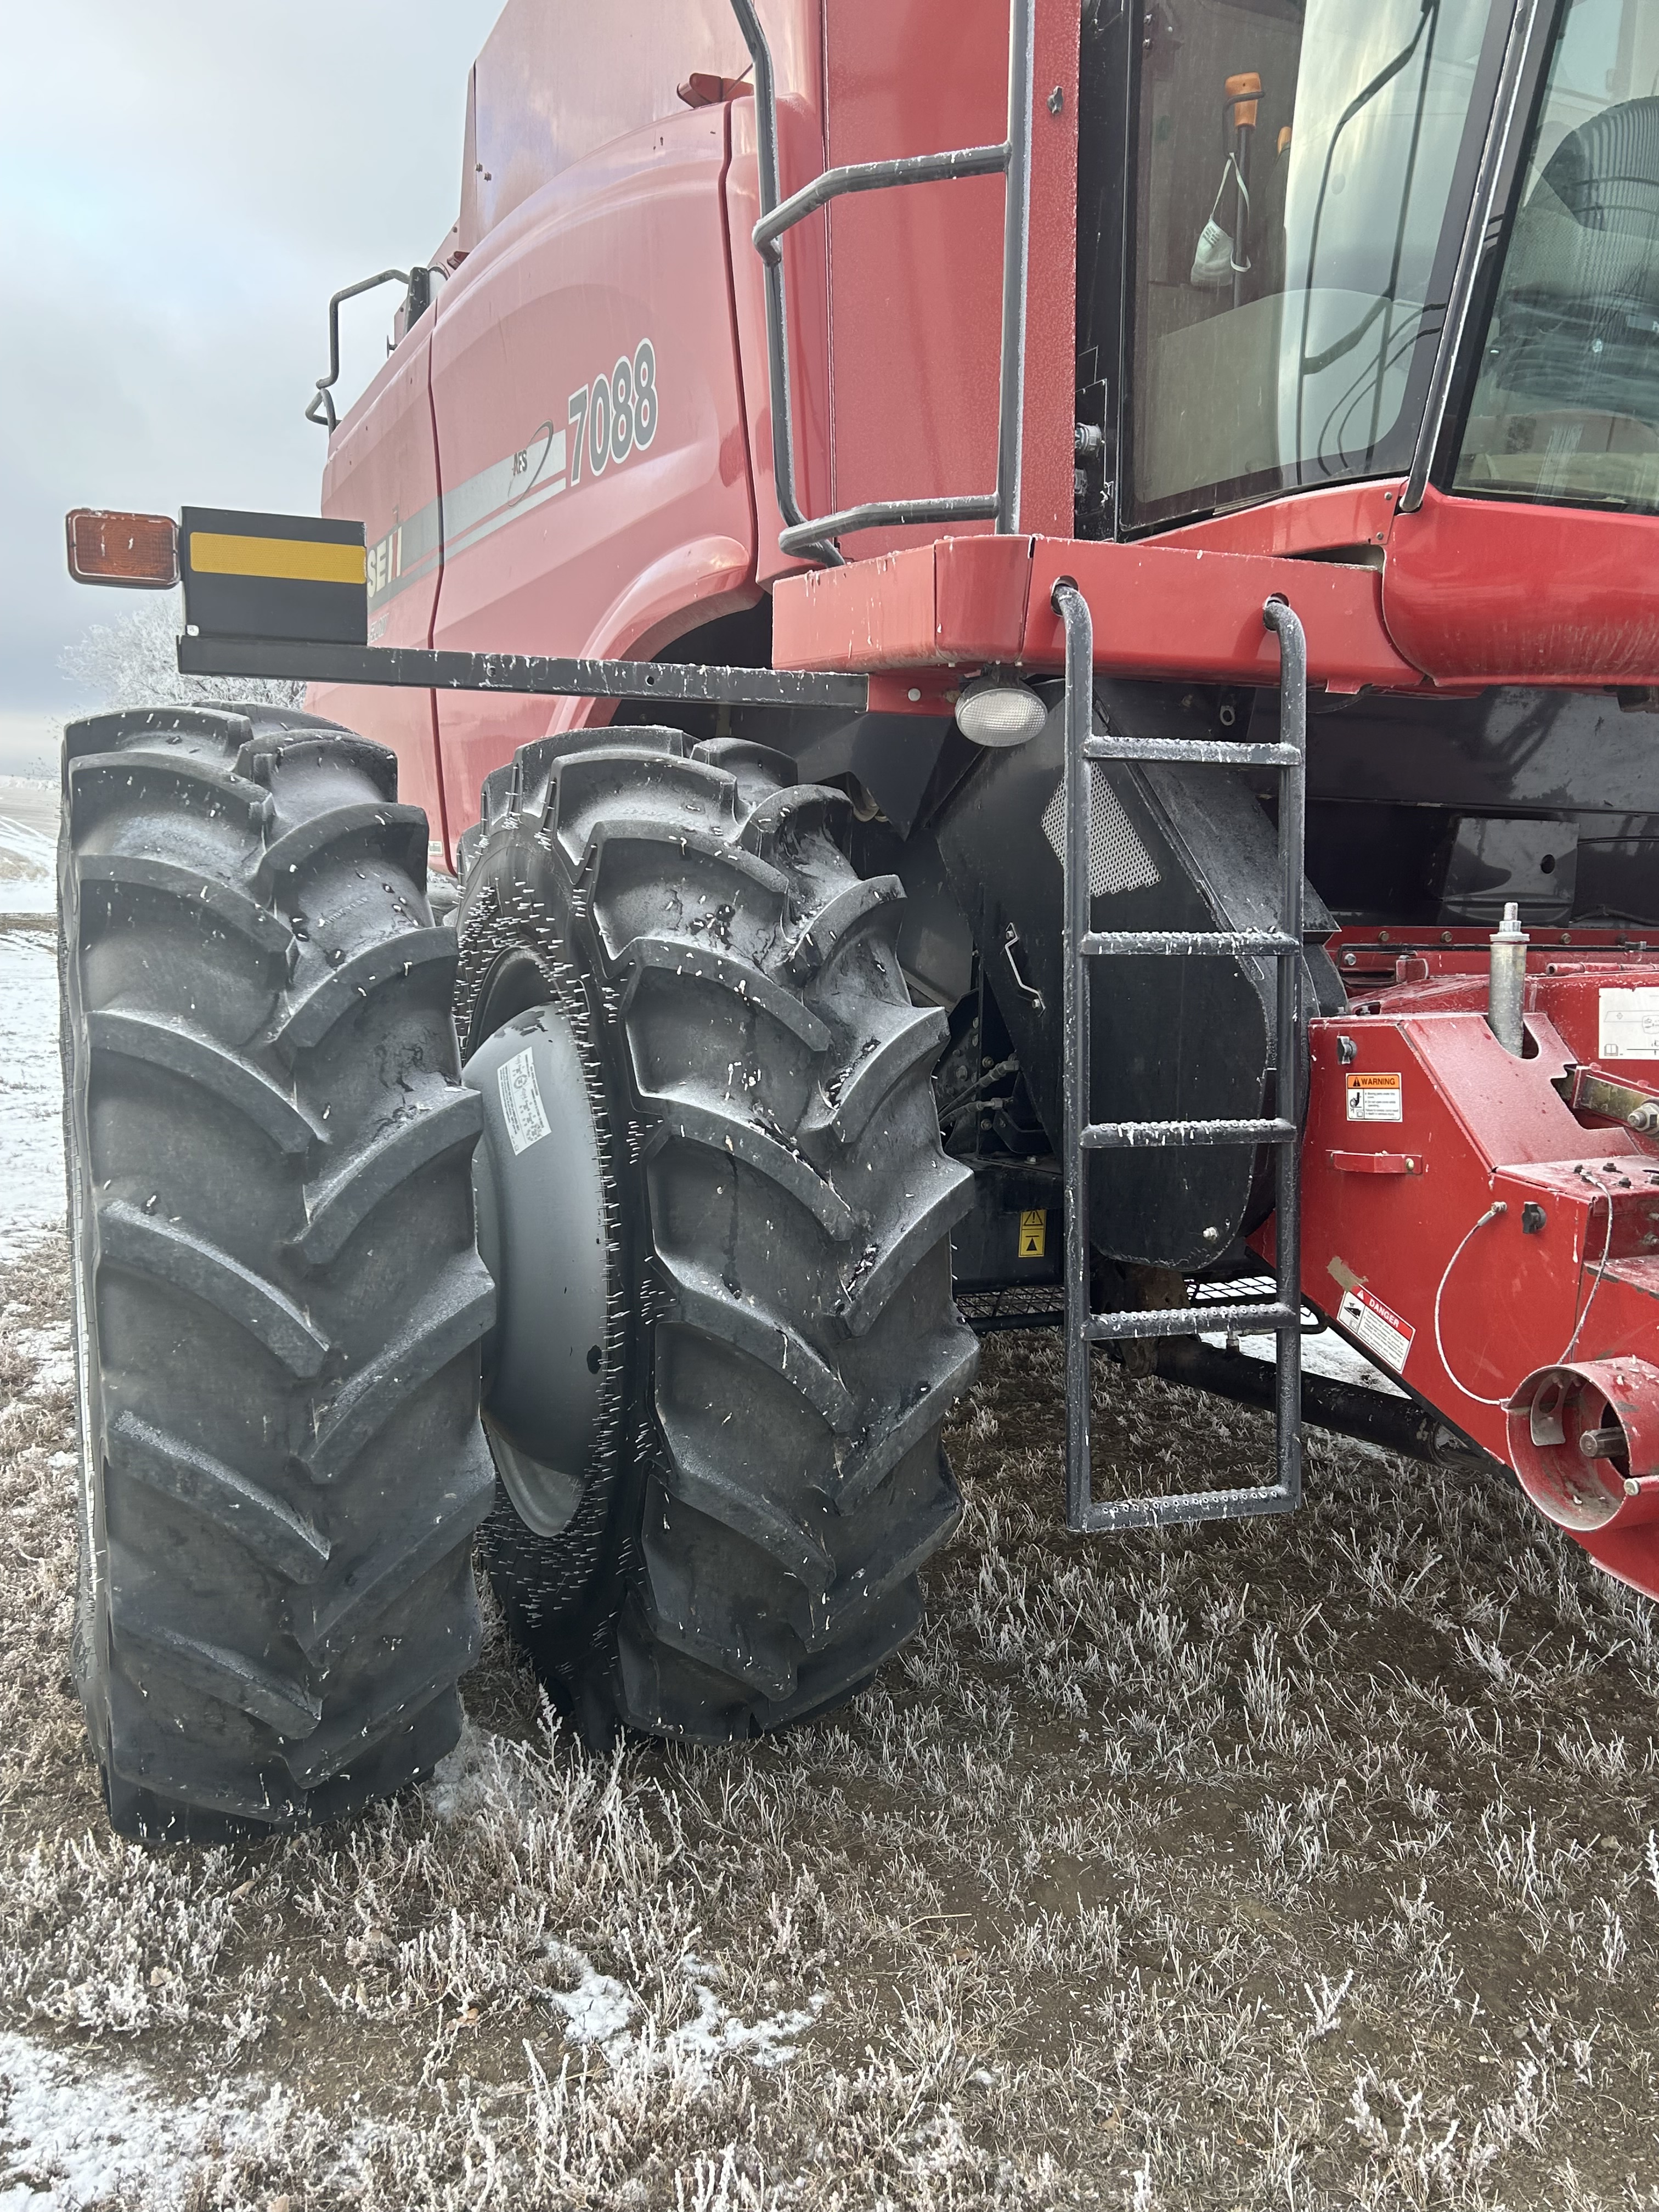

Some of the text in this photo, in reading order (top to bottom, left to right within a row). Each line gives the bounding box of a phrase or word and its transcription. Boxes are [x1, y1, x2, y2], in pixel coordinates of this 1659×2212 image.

[568, 337, 658, 487] 7088
[513, 449, 528, 477] AFS
[1368, 1298, 1400, 1328] DANGER
